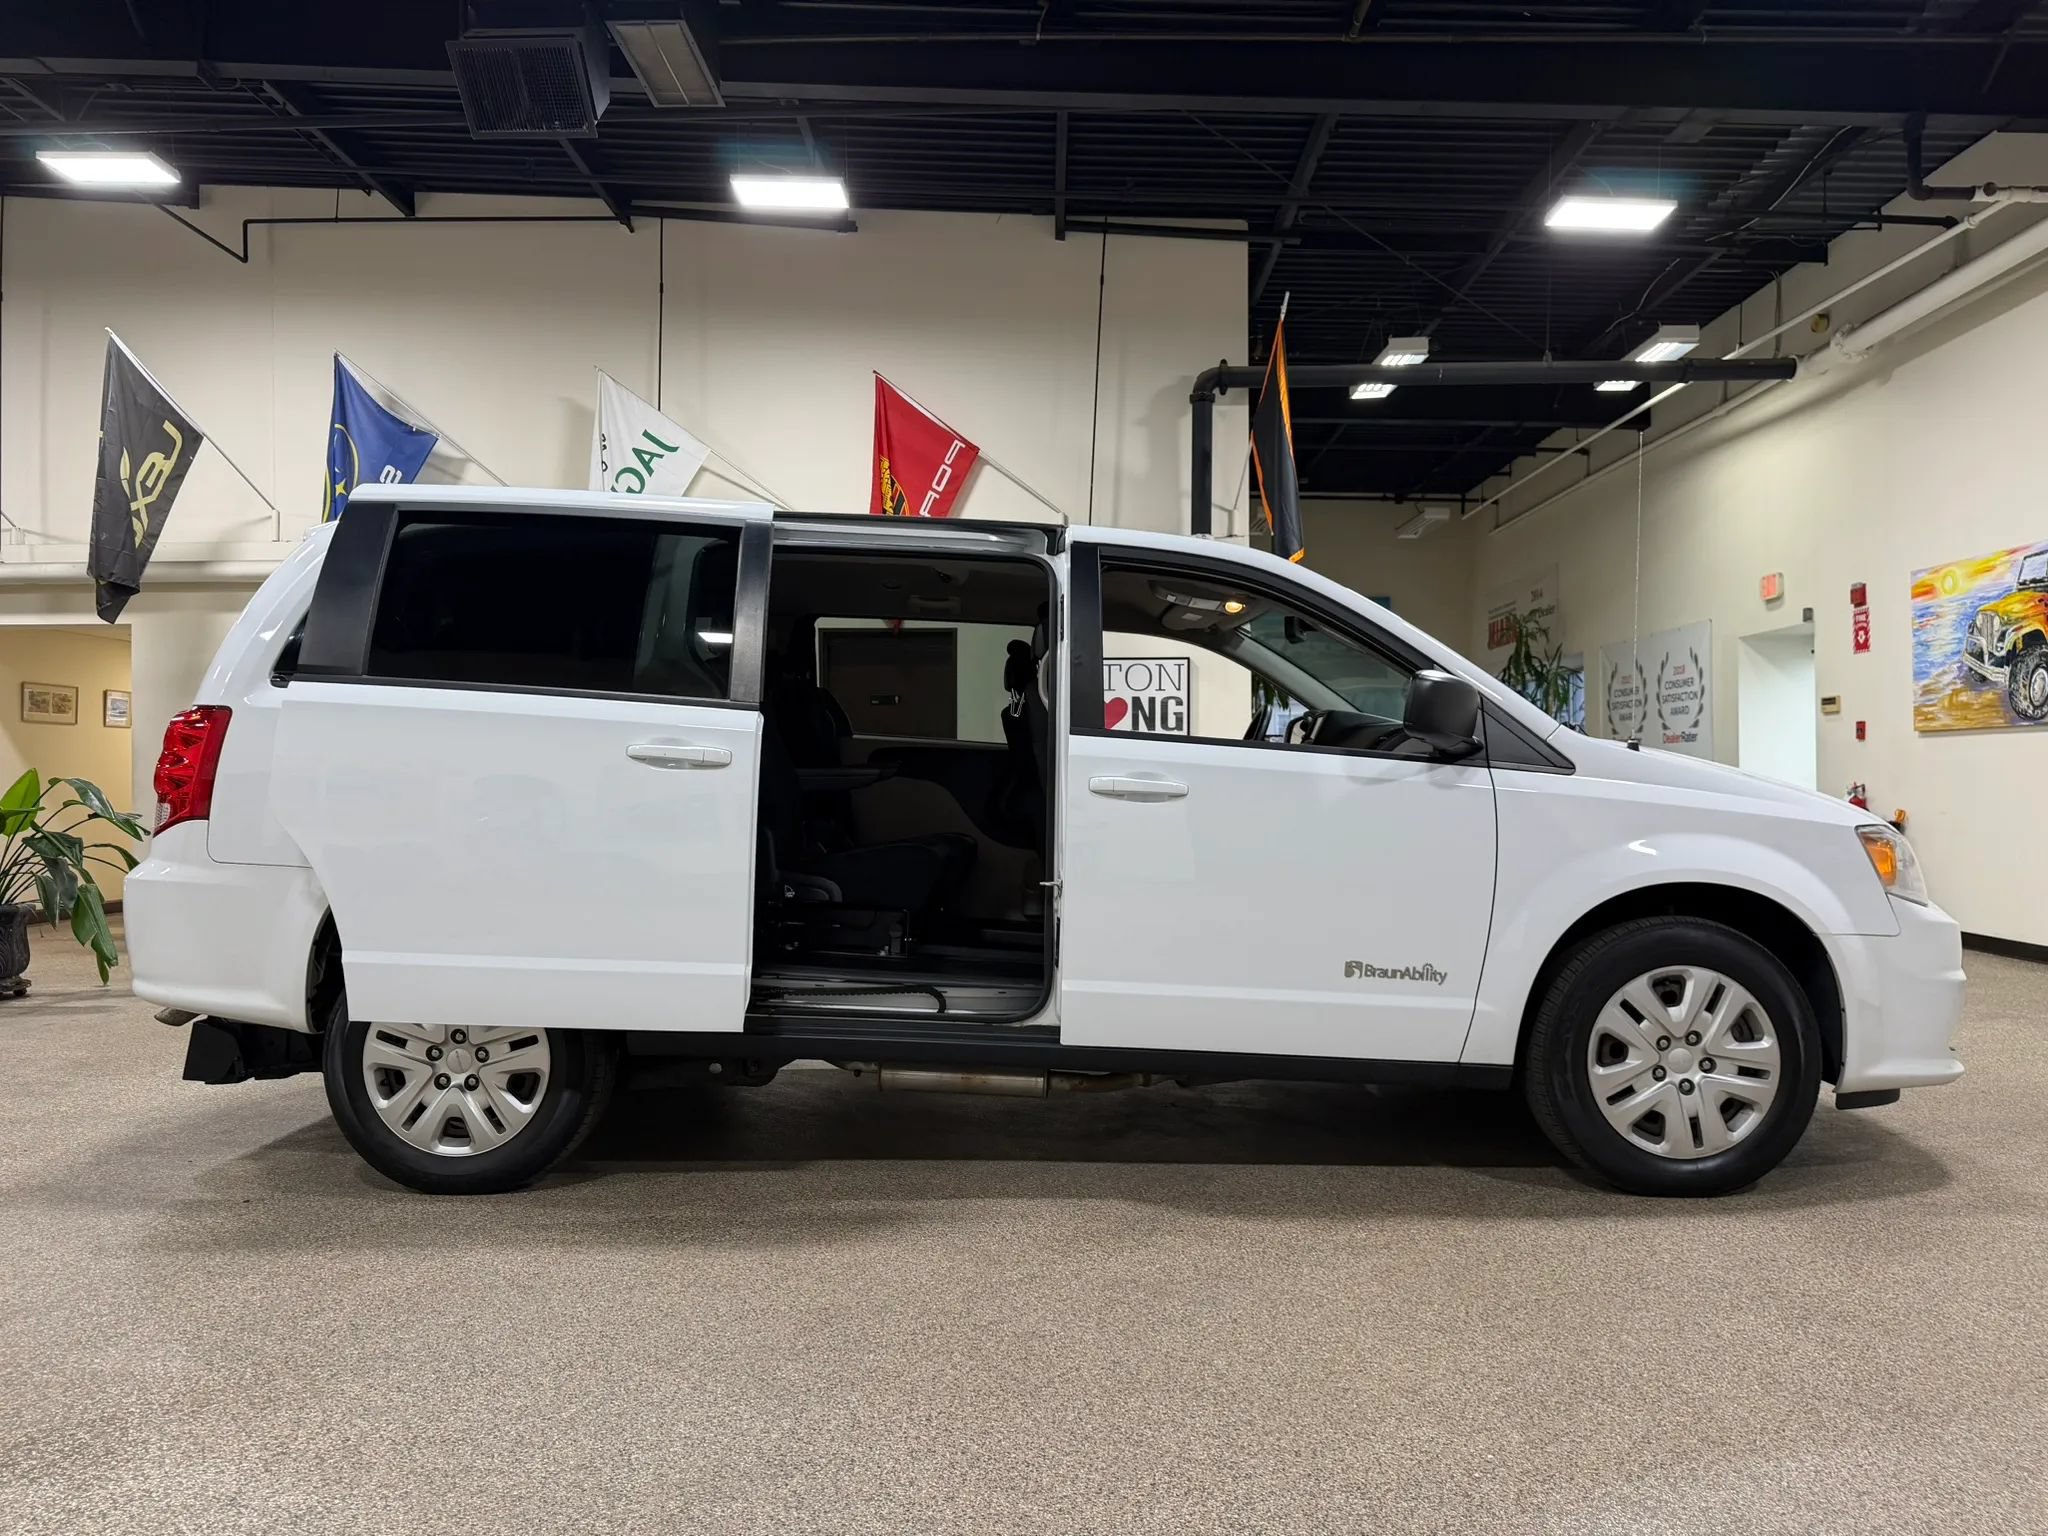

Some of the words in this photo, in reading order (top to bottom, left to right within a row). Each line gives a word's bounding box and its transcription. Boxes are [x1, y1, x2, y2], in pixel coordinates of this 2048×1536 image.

[1664, 677, 1694, 690] CONSUMER
[1661, 691, 1698, 705] SATISFACTION
[1670, 705, 1690, 716] AWARD
[1364, 963, 1448, 985] BraunAbility
